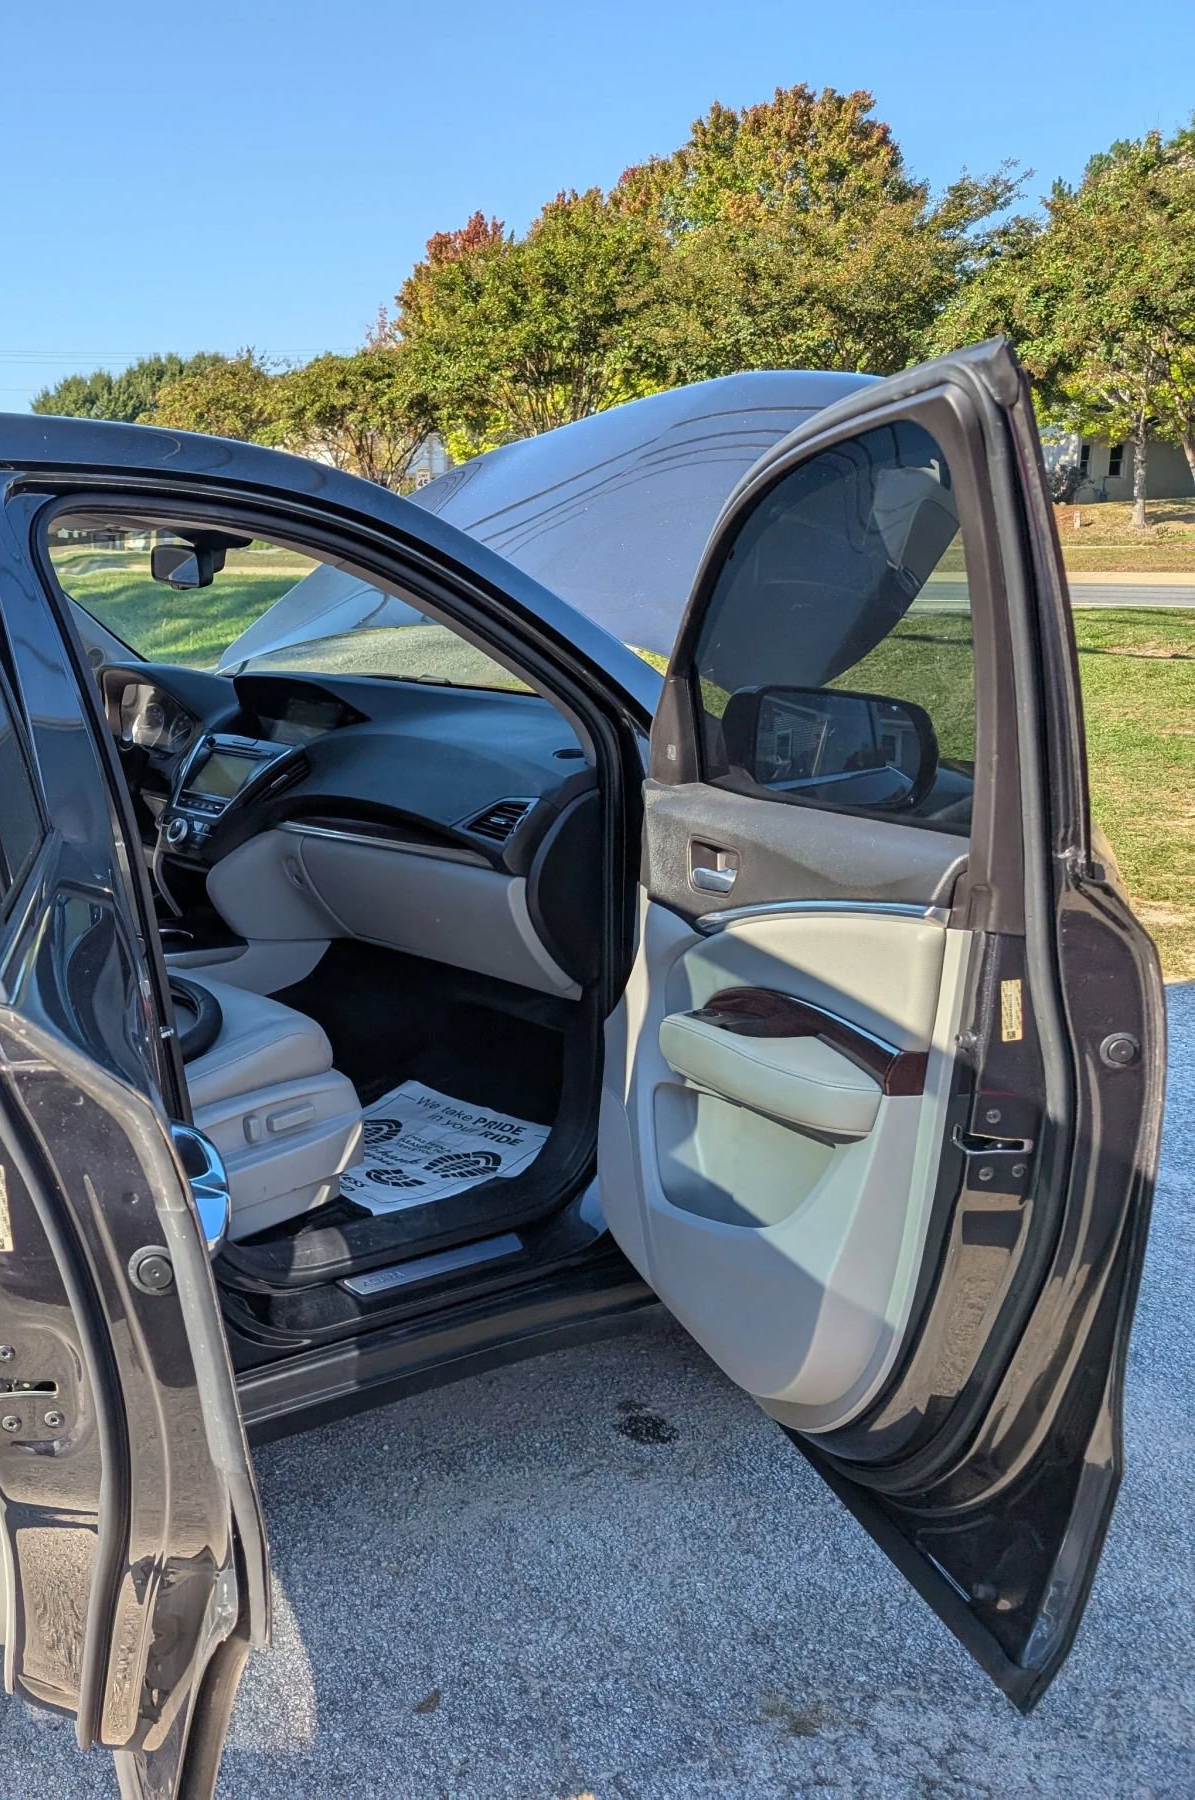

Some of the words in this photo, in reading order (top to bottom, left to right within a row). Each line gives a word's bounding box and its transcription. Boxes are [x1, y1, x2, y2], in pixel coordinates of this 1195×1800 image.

[417, 479, 429, 487] 45
[416, 1096, 440, 1109] We
[442, 1106, 473, 1121] take
[472, 1117, 527, 1136] PRIDE
[428, 1113, 443, 1122] in
[441, 1119, 480, 1133] your
[479, 1131, 525, 1146] RIDE
